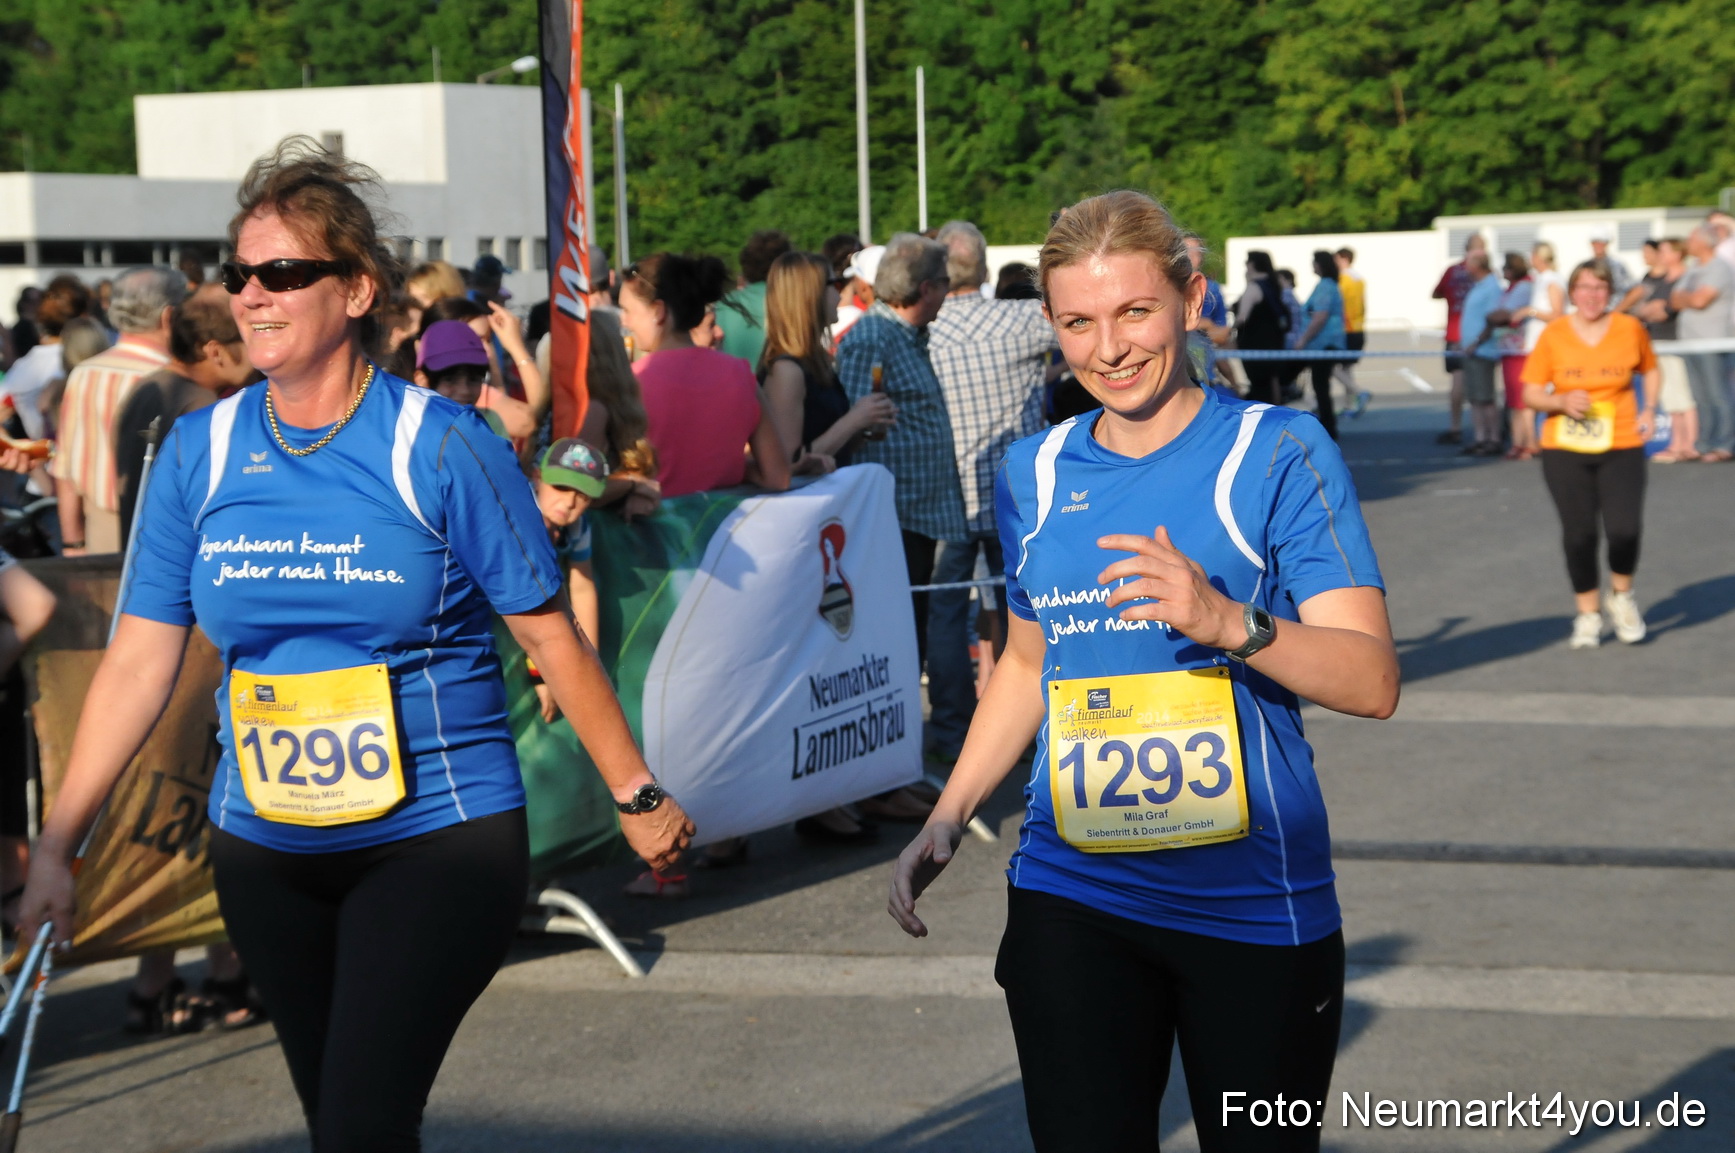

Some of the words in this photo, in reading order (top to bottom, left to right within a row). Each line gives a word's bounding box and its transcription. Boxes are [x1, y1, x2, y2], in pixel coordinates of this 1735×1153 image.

[242, 464, 272, 474] erima
[1061, 502, 1090, 513] erima
[300, 531, 366, 554] kommt
[213, 560, 275, 586] jeder
[278, 562, 327, 580] nach
[333, 556, 405, 584] Hause.
[1048, 614, 1099, 645] jeder
[808, 653, 890, 712] Neumarkter
[247, 699, 298, 712] firmenlauf
[1078, 705, 1134, 720] firmenlauf
[791, 694, 905, 780] Lammsbräu
[1061, 727, 1107, 742] walken
[241, 722, 390, 787] 1296
[1059, 731, 1233, 809] 1293
[288, 789, 320, 800] Manuela
[321, 789, 345, 798] März
[310, 803, 345, 812] Donauer
[347, 799, 375, 808] GmbH
[1124, 811, 1143, 822] Mila
[1145, 809, 1169, 820] Graf
[1086, 827, 1131, 838] Siebentritt
[1141, 825, 1182, 835] Donauer
[1184, 819, 1215, 831] GmbH
